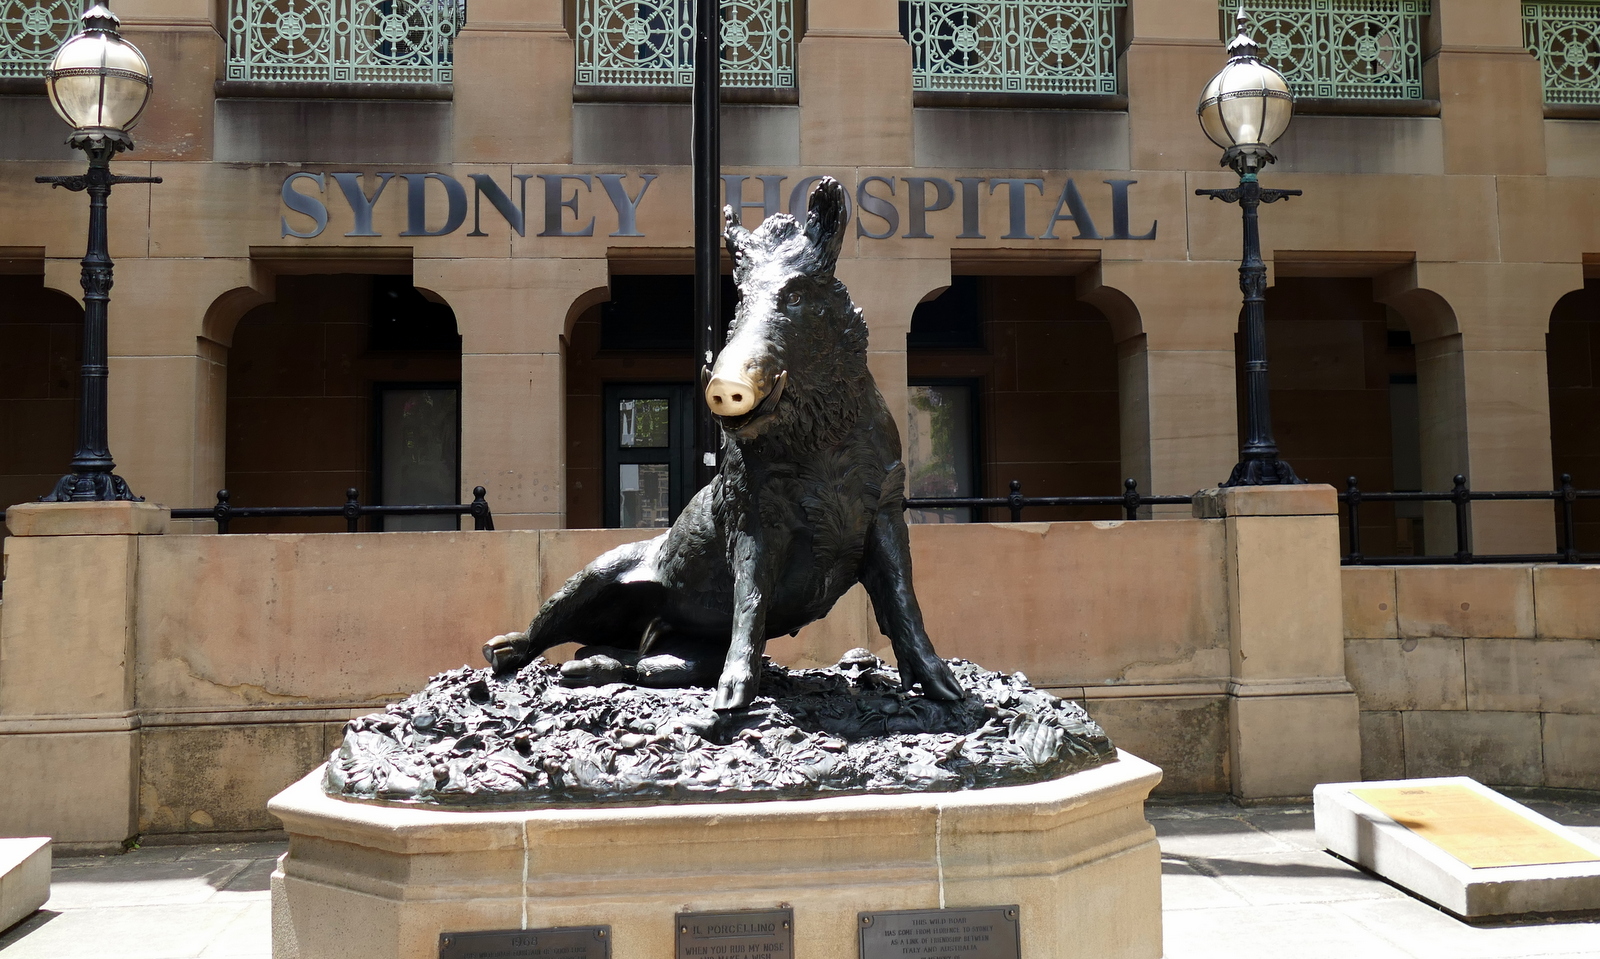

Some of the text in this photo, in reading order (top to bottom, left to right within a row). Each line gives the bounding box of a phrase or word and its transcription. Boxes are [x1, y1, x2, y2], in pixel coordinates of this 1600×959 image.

[281, 171, 657, 239] SYDNEY
[708, 924, 776, 934] PORCELLINO
[512, 936, 538, 947] 1968
[685, 943, 784, 956] WHEN YOU RUB MY NOSE
